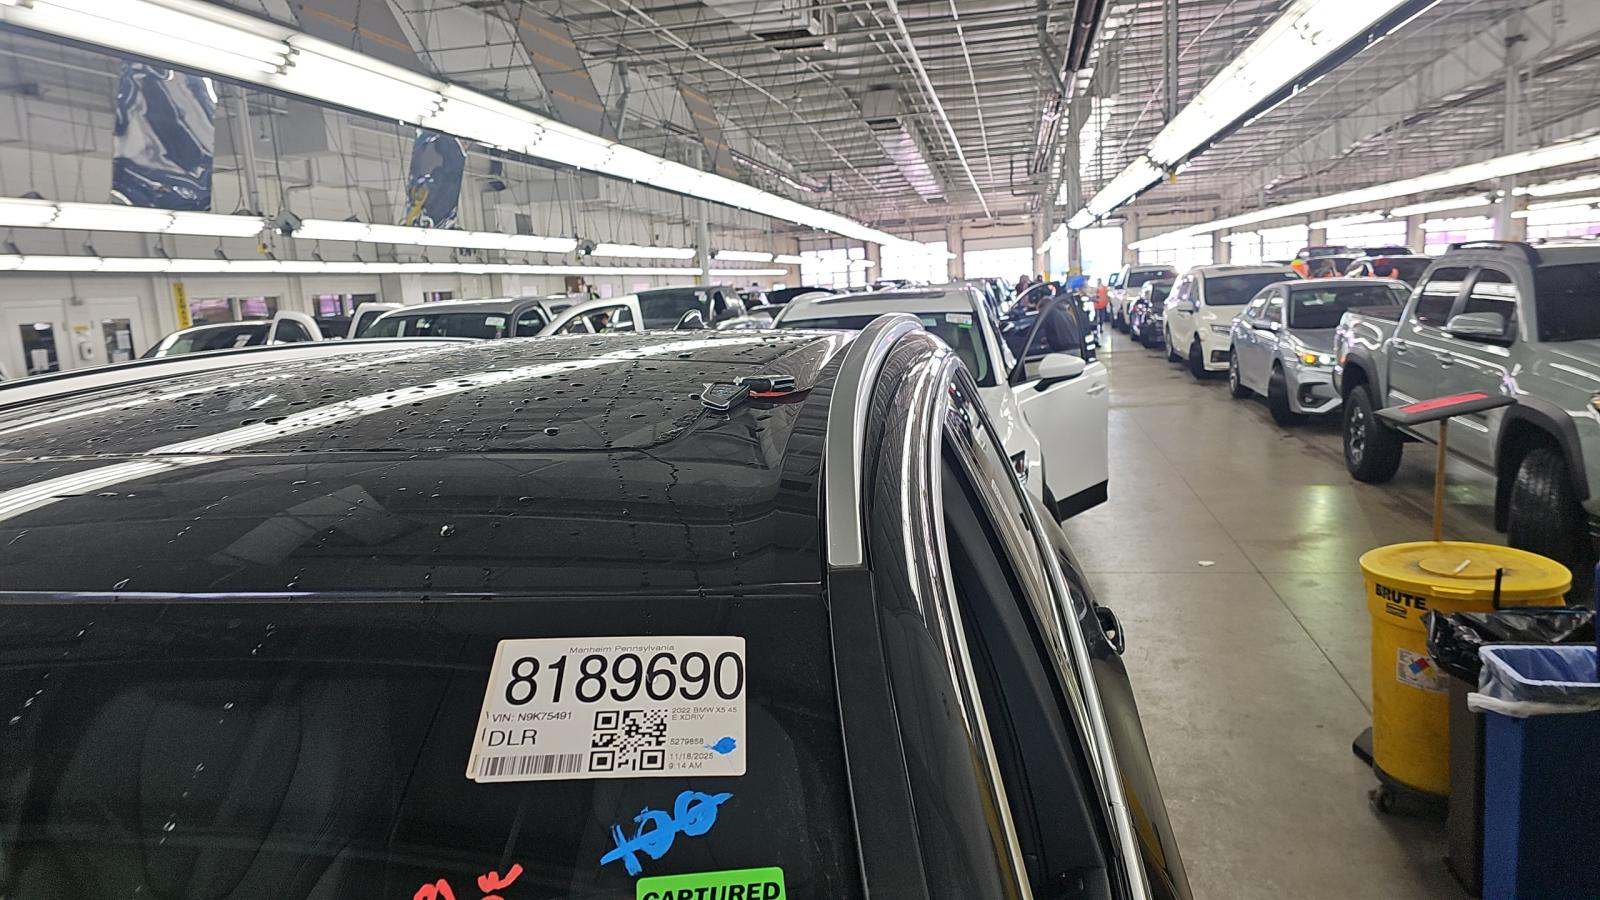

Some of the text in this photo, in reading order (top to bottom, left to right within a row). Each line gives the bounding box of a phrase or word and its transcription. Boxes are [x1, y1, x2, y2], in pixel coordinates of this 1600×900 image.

[1376, 583, 1427, 611] BRUTE
[569, 644, 675, 654] Manheim Pennsylvania
[504, 651, 744, 706] 8189690
[671, 707, 691, 715] 2022
[693, 706, 714, 714] BMW
[716, 706, 726, 714] X5
[492, 711, 572, 723] VIN: N9K75491
[488, 728, 538, 747] DLR
[670, 752, 714, 761] 11/18/2025
[688, 761, 703, 769] AM
